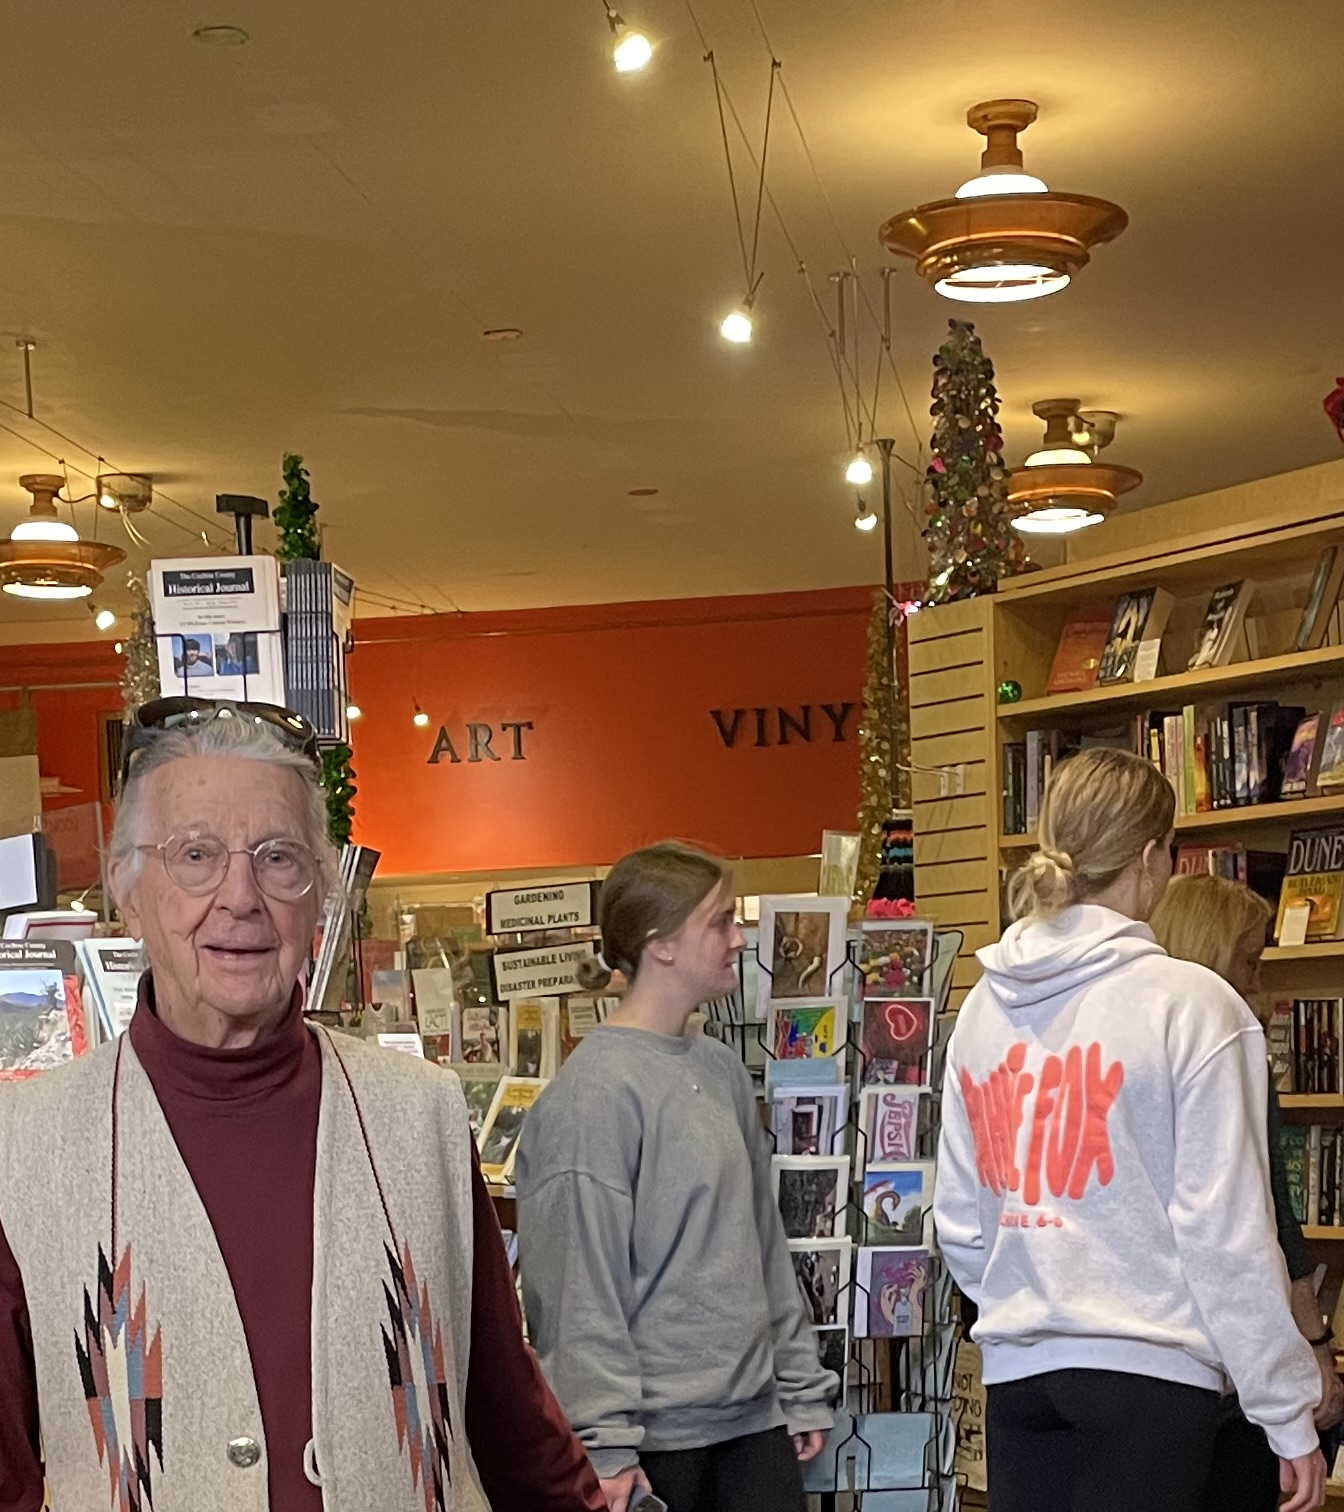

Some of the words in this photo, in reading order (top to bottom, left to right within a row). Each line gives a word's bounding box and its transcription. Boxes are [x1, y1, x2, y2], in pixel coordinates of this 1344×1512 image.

[168, 582, 214, 594] Historical
[216, 581, 249, 593] Journal
[709, 702, 854, 749] VINY
[427, 721, 534, 764] ART
[514, 890, 564, 905] GARDENING
[500, 915, 545, 929] MEDICINAL
[547, 911, 579, 924] PLANTS
[24, 950, 57, 959] Journal
[502, 953, 557, 971] SUSTAINABLE
[499, 980, 536, 993] DISASTER
